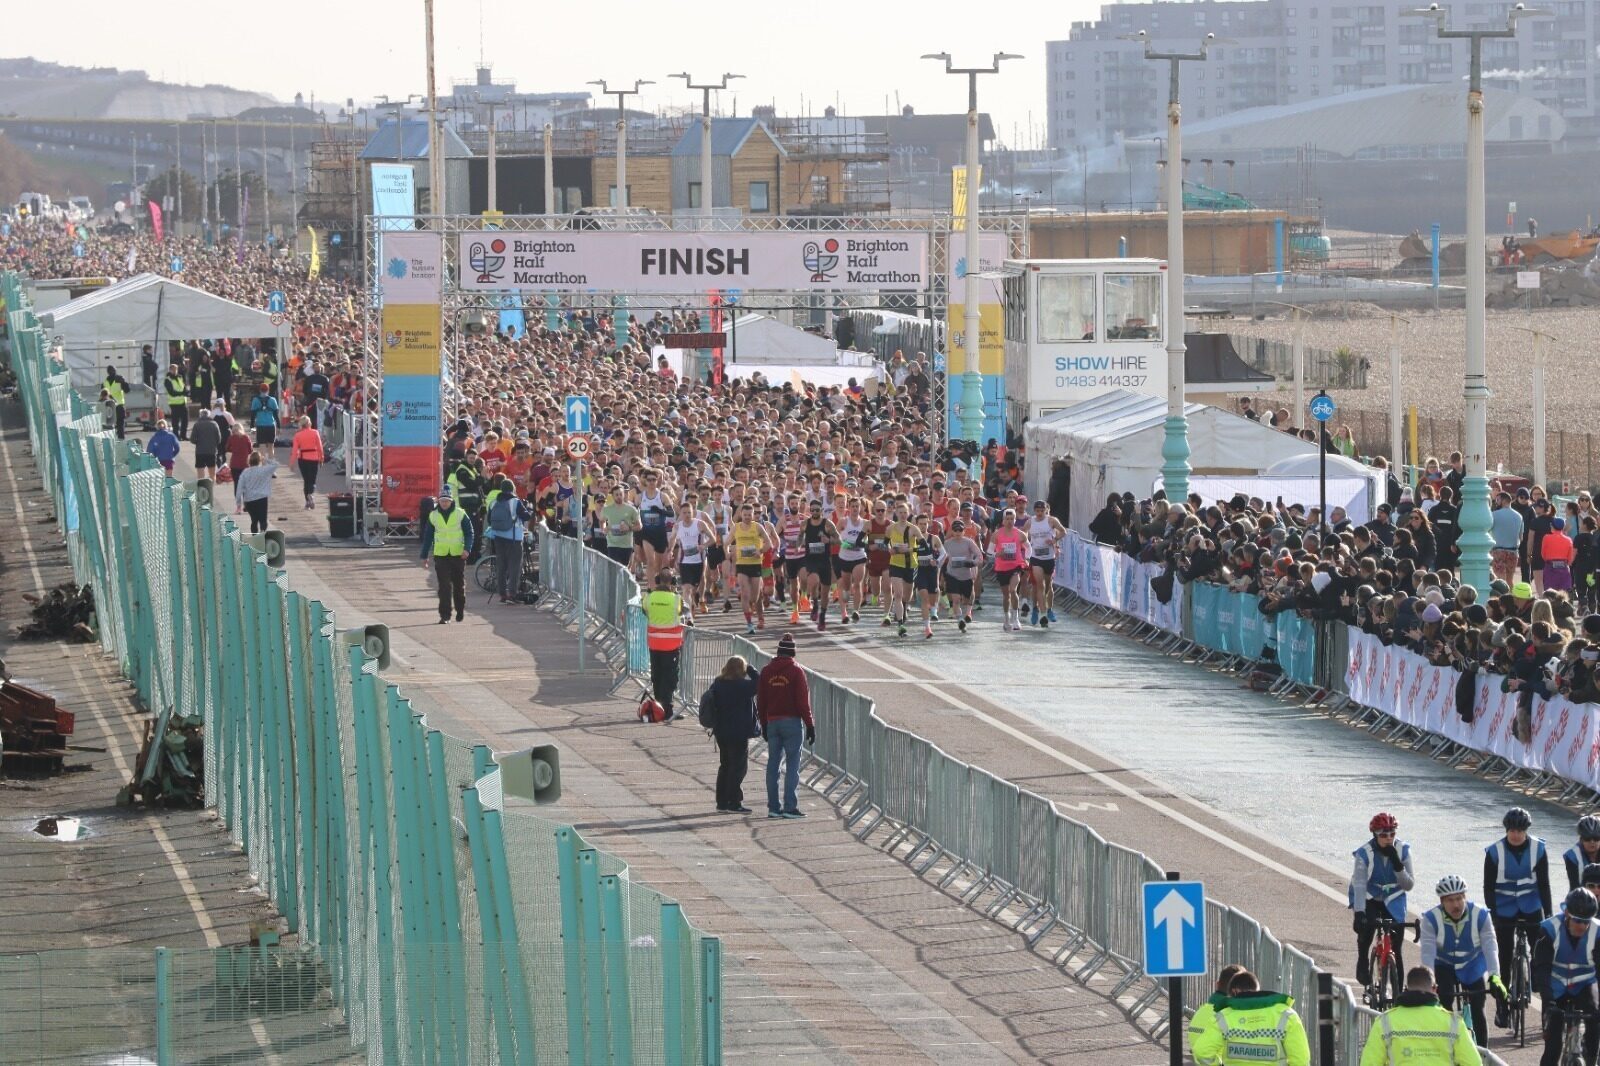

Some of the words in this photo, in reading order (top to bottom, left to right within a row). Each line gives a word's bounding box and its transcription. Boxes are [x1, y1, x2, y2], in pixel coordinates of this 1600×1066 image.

[513, 240, 575, 255] Brighton
[846, 239, 909, 254] Brighton
[513, 256, 545, 268] Half
[641, 248, 749, 275] FINISH
[846, 255, 878, 267] Half
[513, 271, 587, 284] Marathon
[846, 270, 921, 283] Marathon
[1055, 356, 1109, 371] SHOW
[1111, 356, 1148, 370] HIRE
[1055, 375, 1097, 388] 01483
[1098, 375, 1148, 387] 414337
[570, 441, 587, 452] 20
[1228, 1046, 1275, 1057] PARAMEDIC
